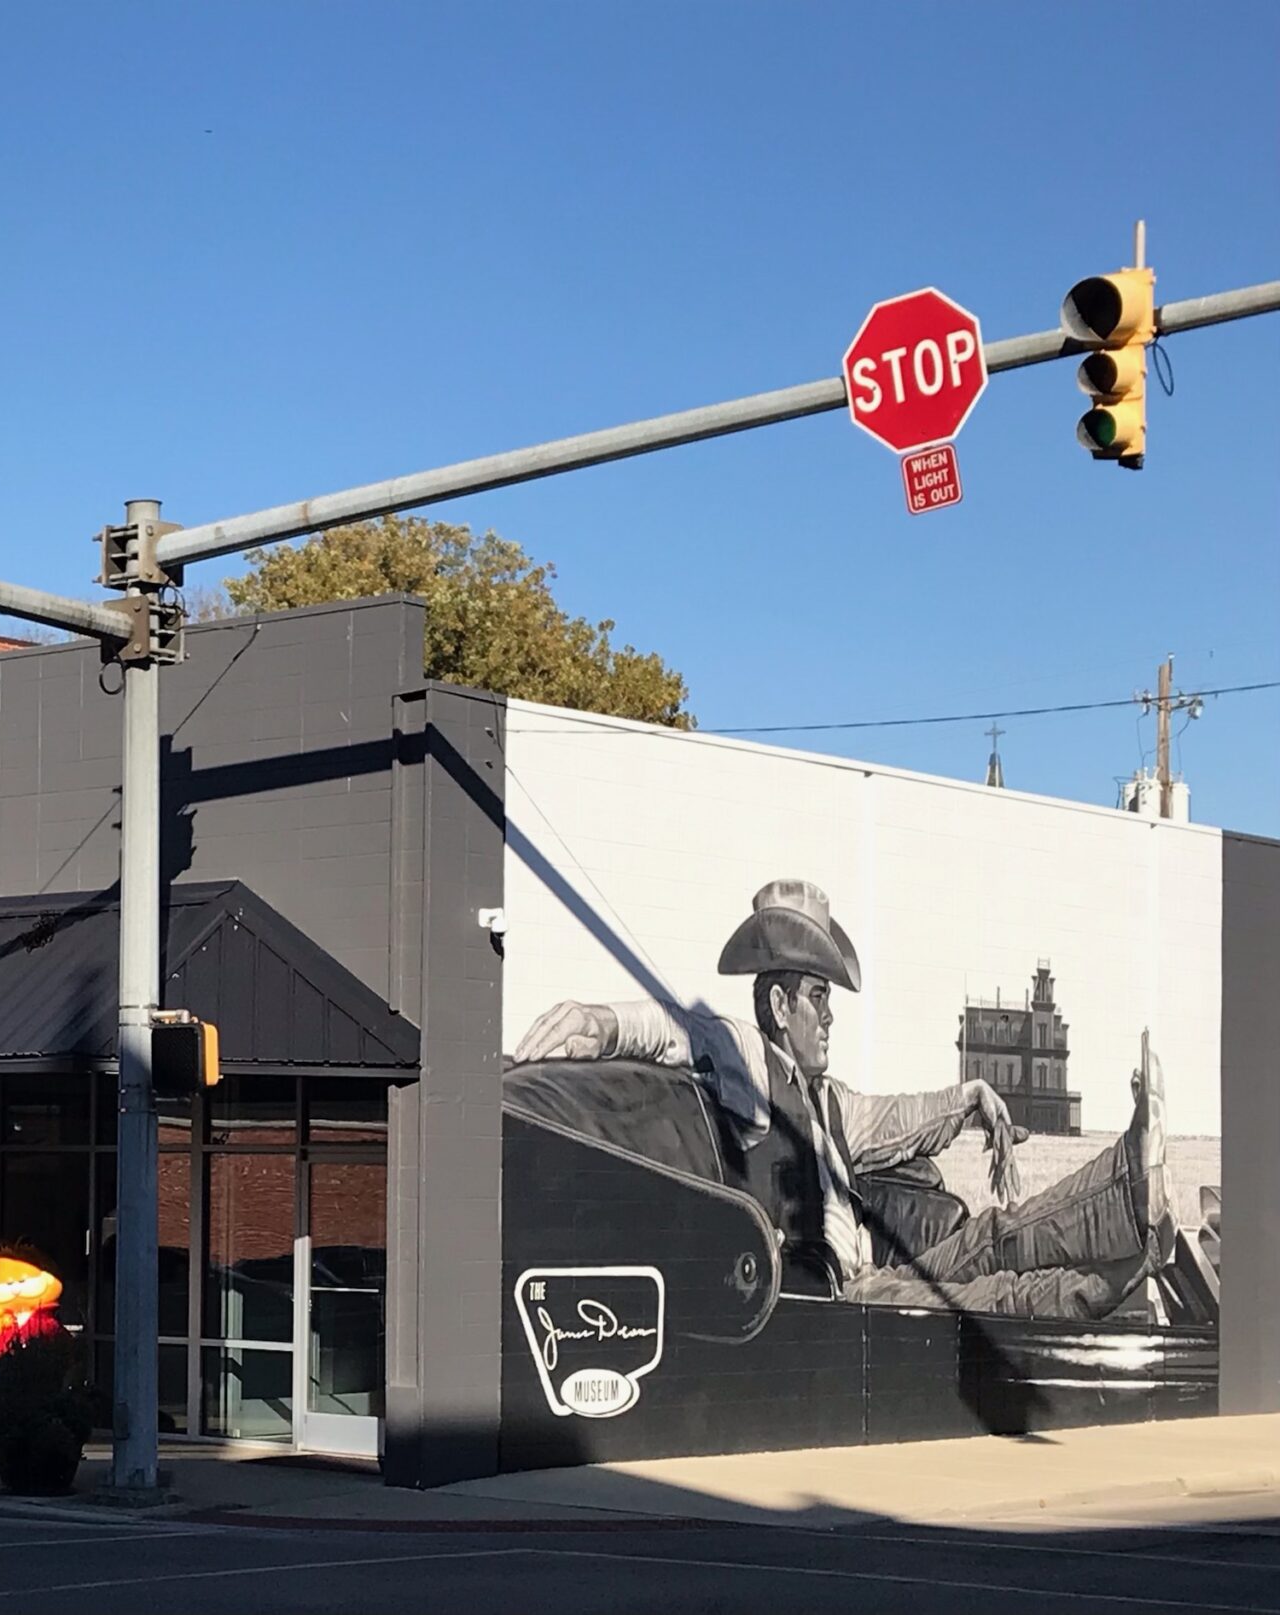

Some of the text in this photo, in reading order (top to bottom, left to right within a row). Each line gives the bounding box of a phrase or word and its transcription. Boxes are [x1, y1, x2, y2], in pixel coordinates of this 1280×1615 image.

[852, 329, 976, 413] STOP
[911, 450, 948, 473] WHEN
[913, 468, 949, 491] LIGHT
[913, 483, 955, 508] IS OUT
[529, 1281, 546, 1301] THE
[577, 1299, 657, 1342] Dean
[574, 1379, 620, 1403] MUSEUM
